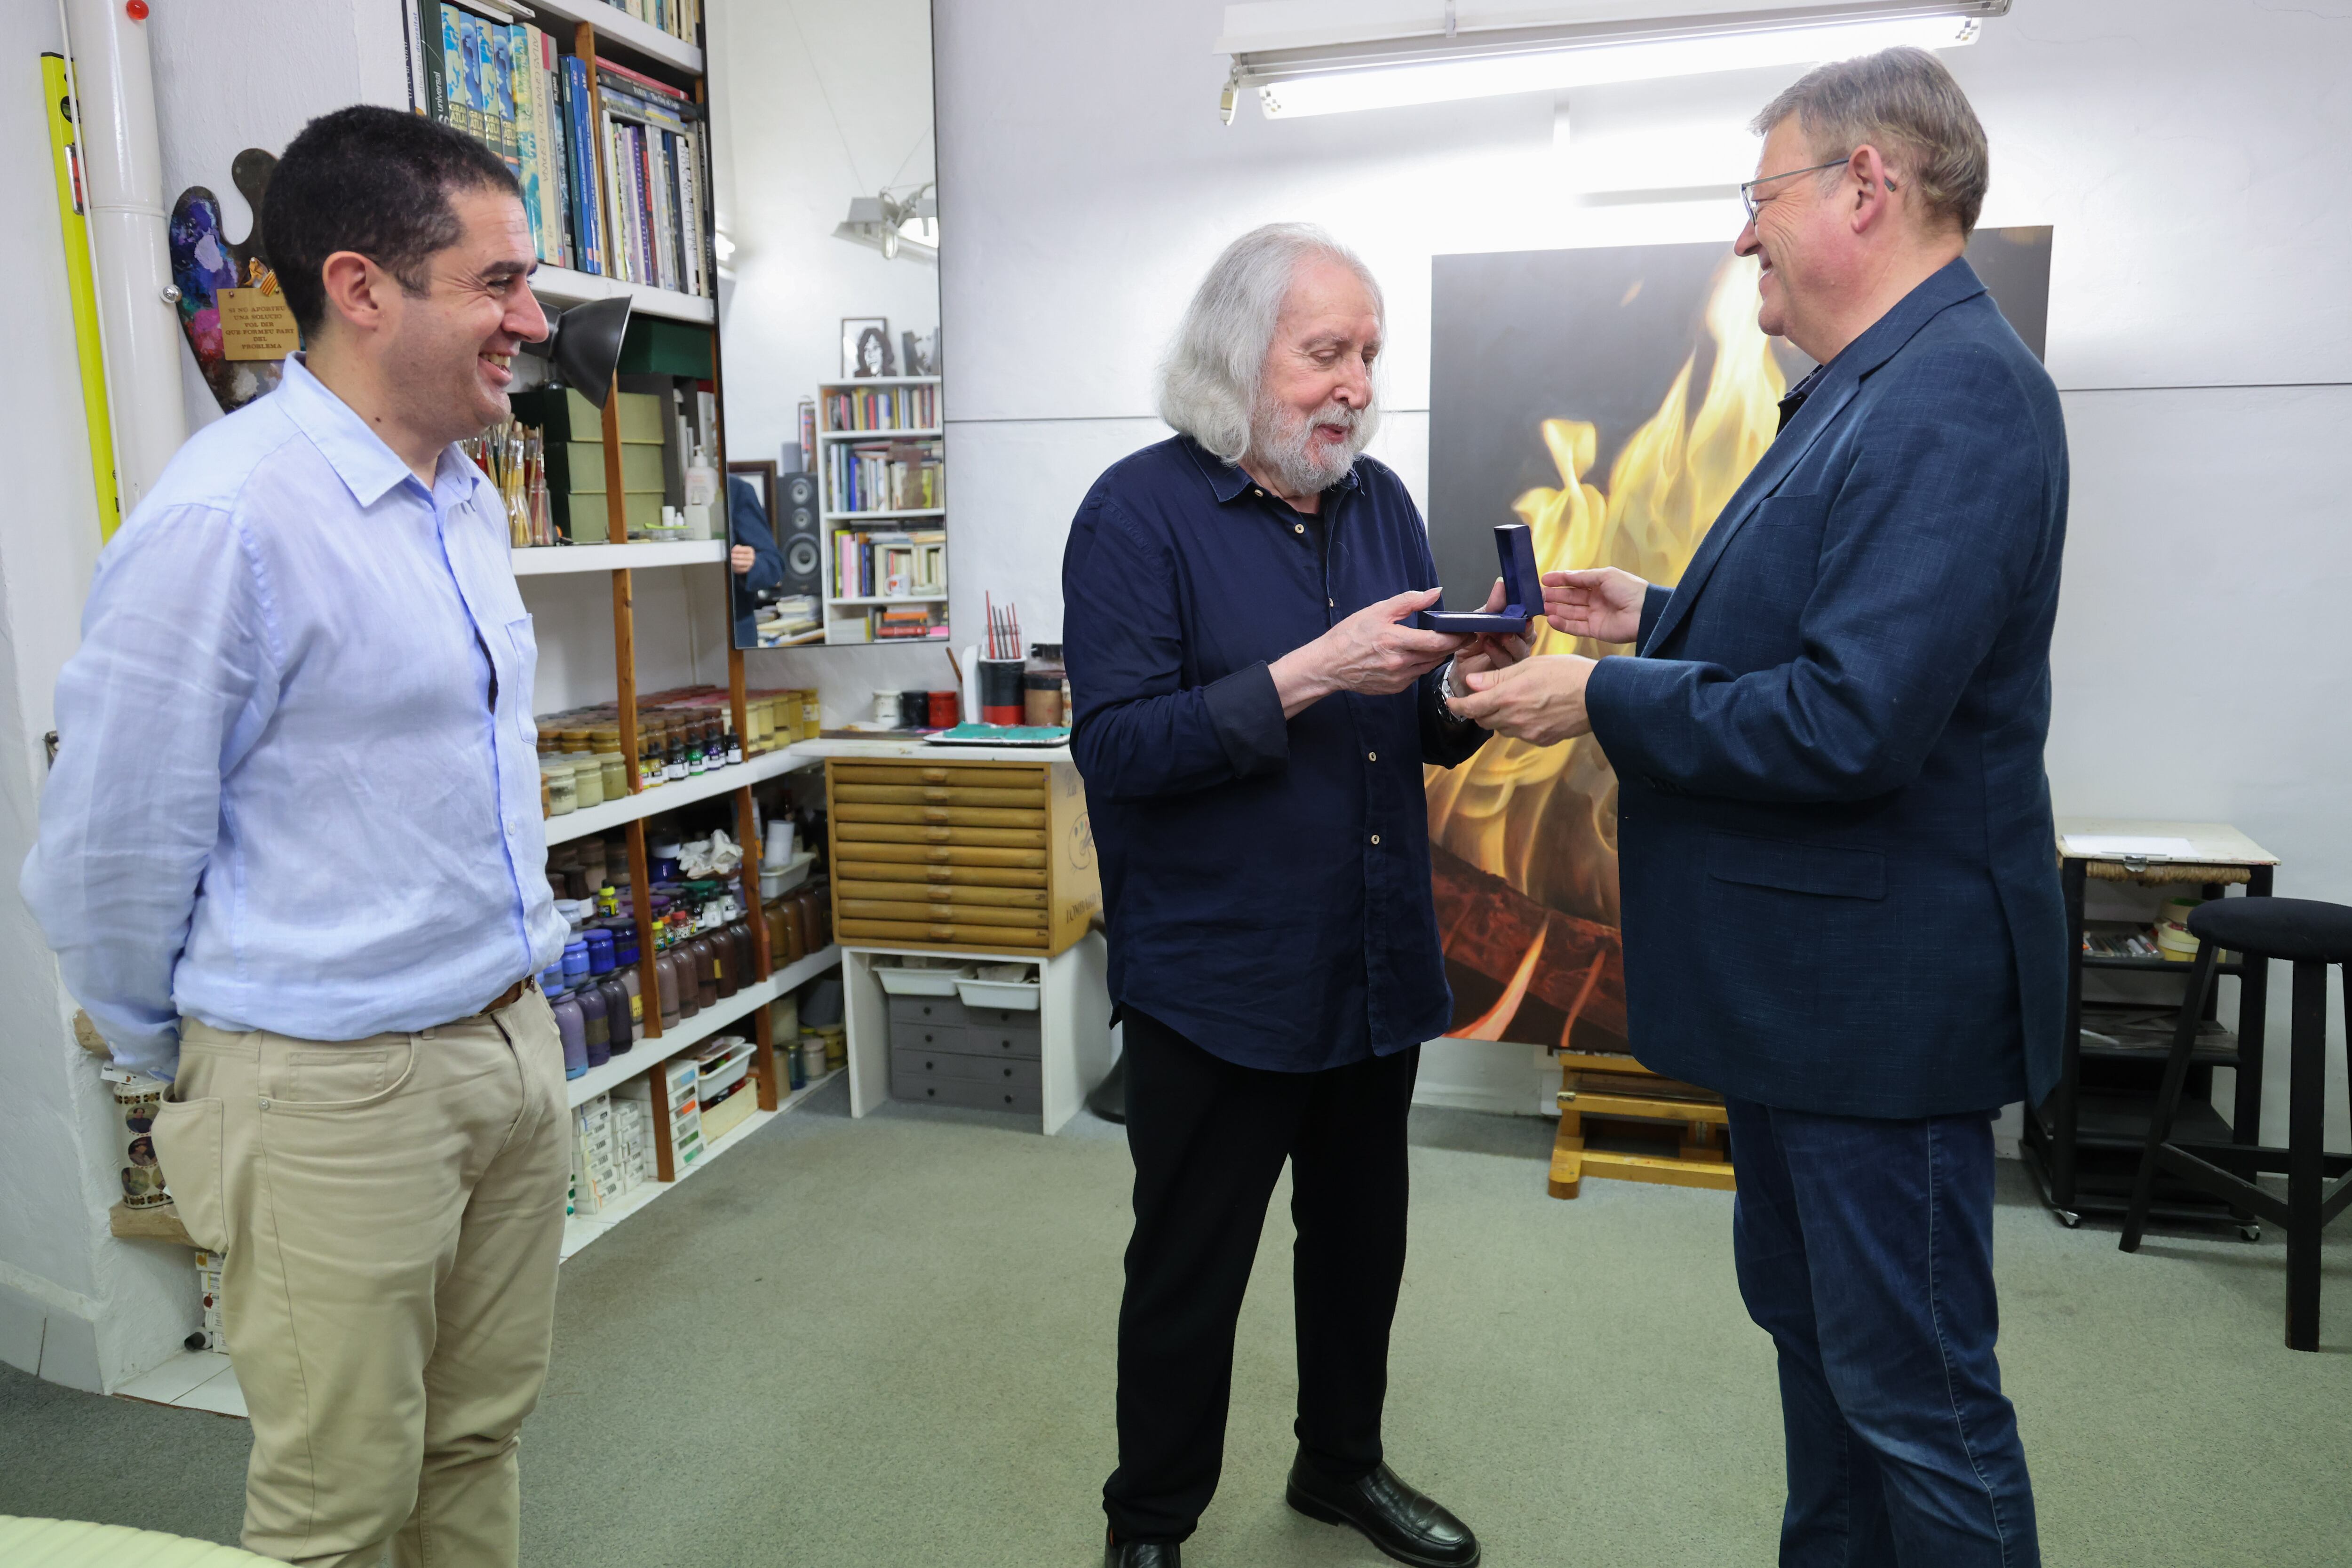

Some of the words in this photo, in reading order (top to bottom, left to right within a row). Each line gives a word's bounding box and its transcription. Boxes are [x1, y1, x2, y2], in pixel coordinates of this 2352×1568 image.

[433, 71, 444, 111] universal
[532, 34, 540, 69] ATLAS
[540, 137, 549, 181] ESPAÑA
